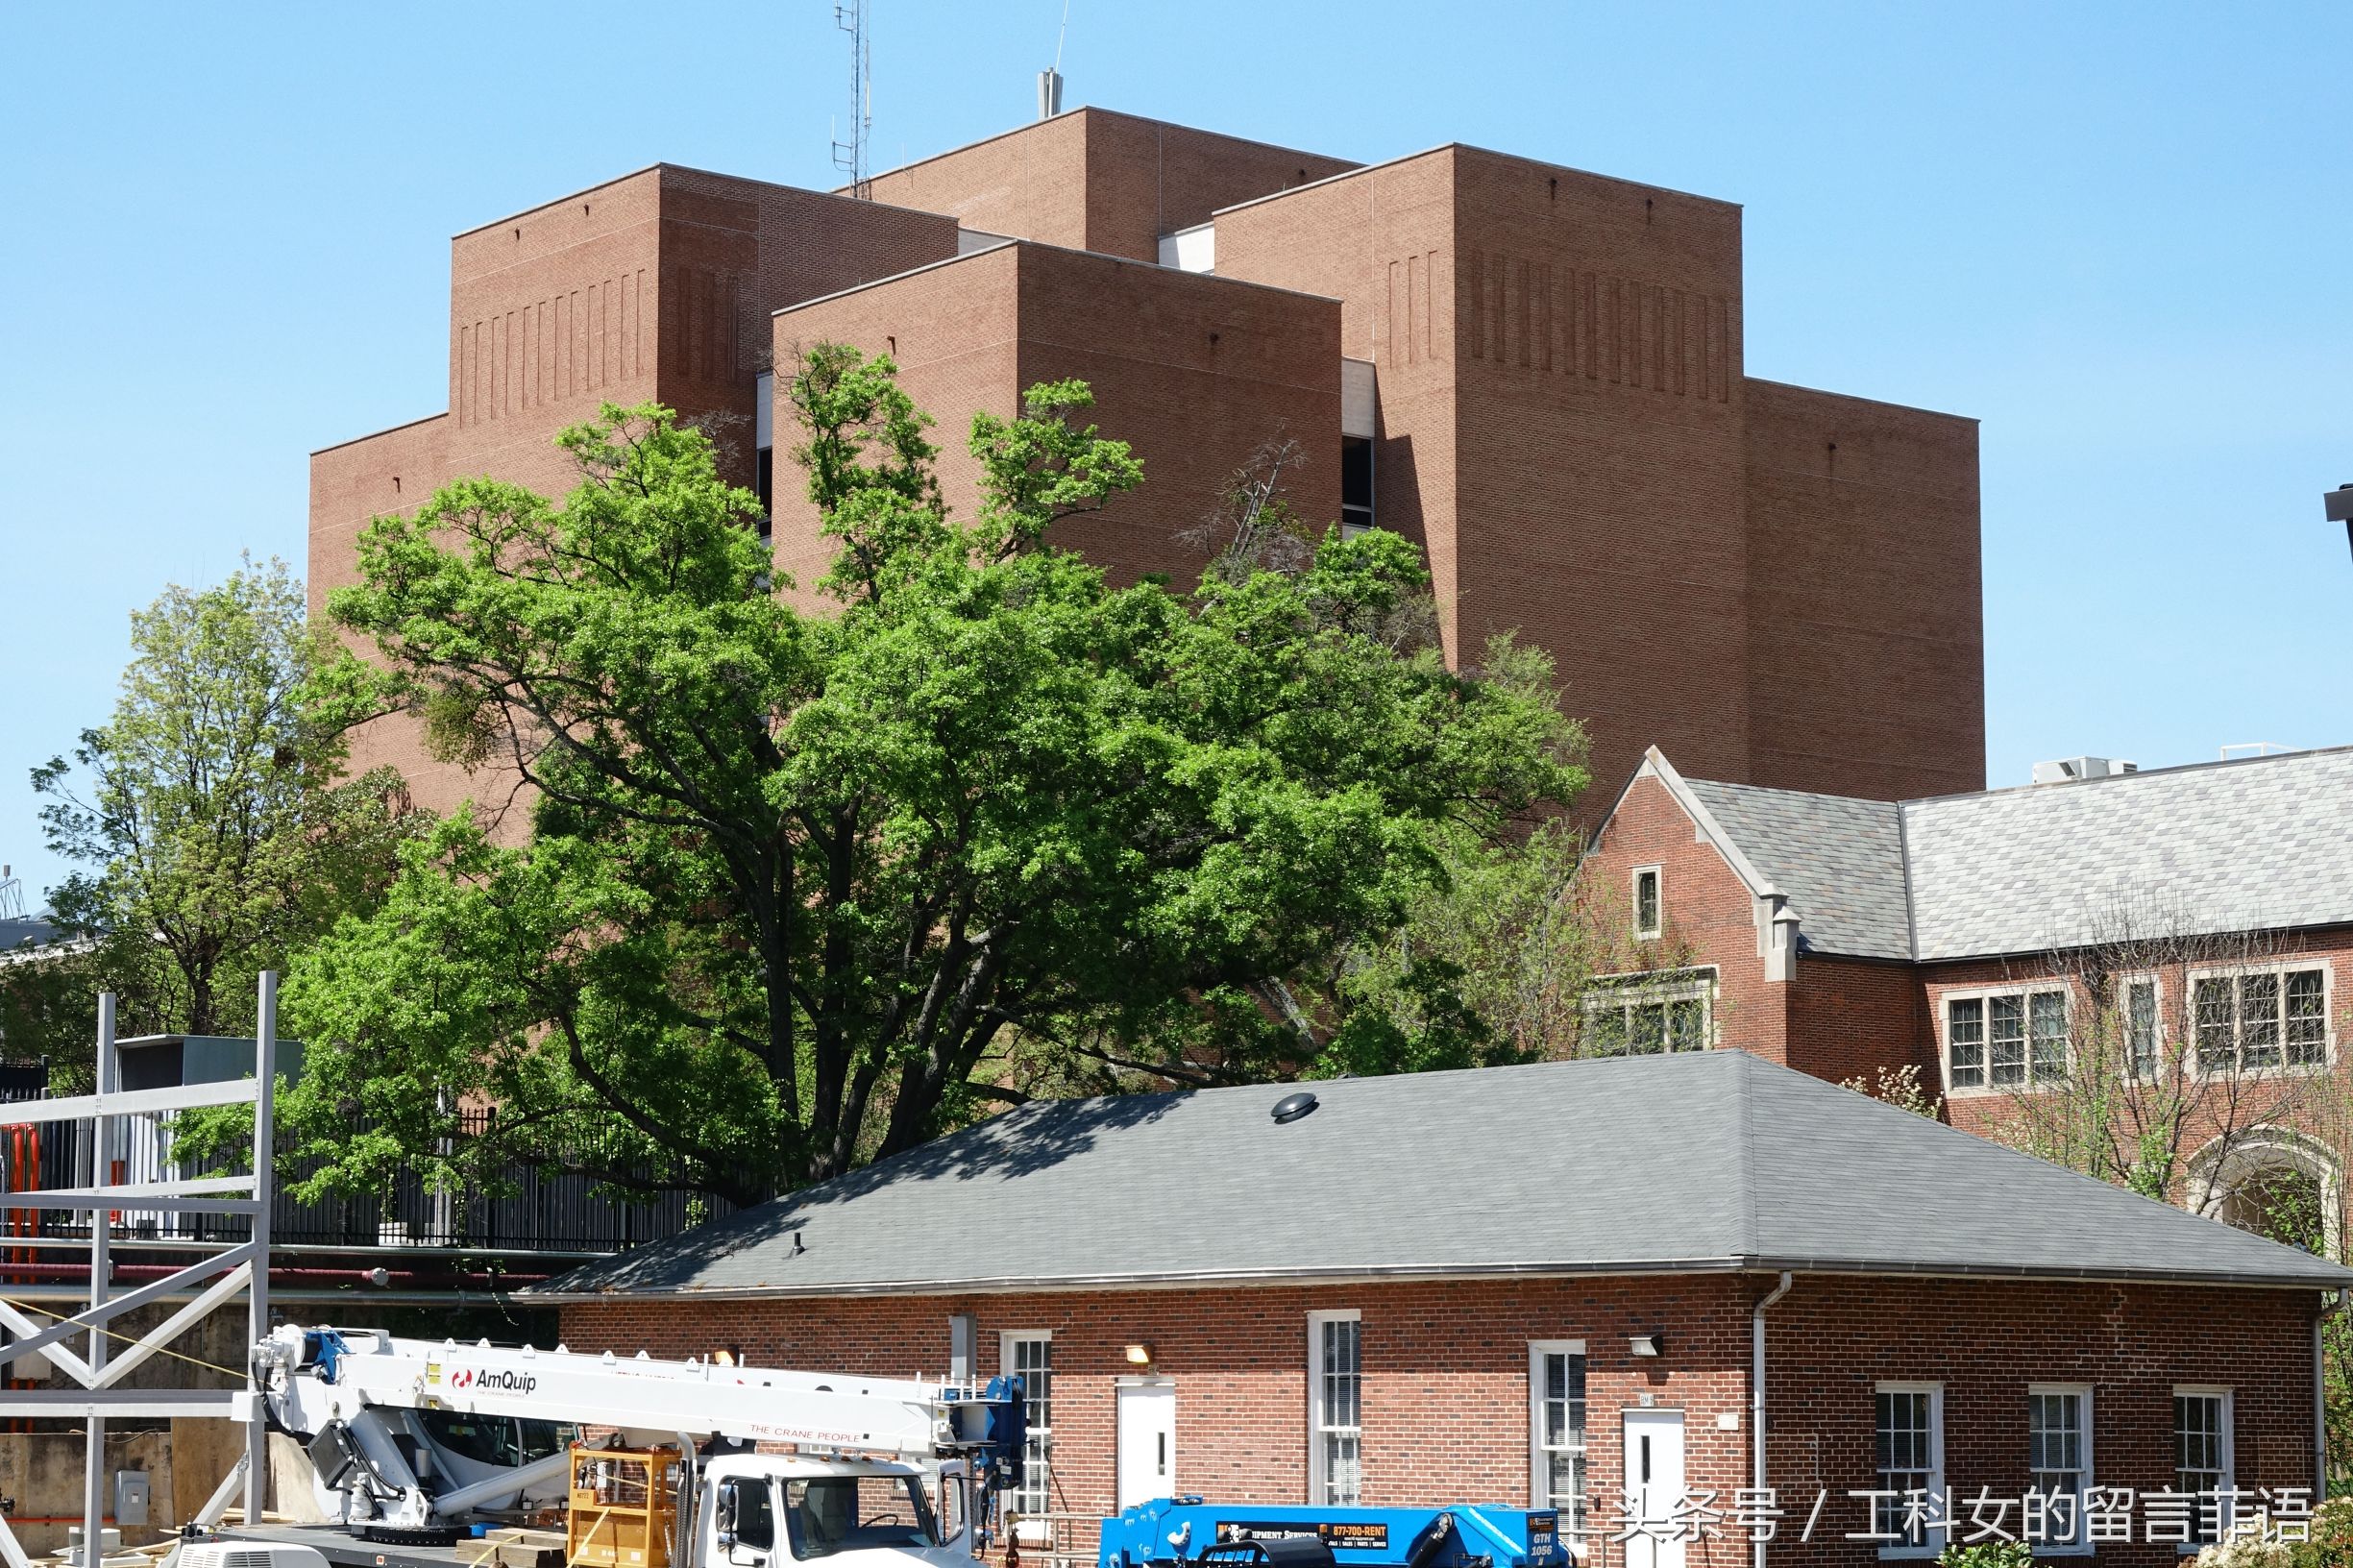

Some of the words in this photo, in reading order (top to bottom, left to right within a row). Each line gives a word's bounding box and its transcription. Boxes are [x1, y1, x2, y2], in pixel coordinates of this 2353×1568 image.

[476, 1369, 536, 1395] AmQuip
[750, 1424, 770, 1434] THE
[774, 1428, 813, 1438] CRANE
[818, 1432, 861, 1443] PEOPLE
[1334, 1526, 1386, 1536] 877-700-RENT
[1533, 1532, 1552, 1544] GTH
[1531, 1544, 1553, 1556] 1056
